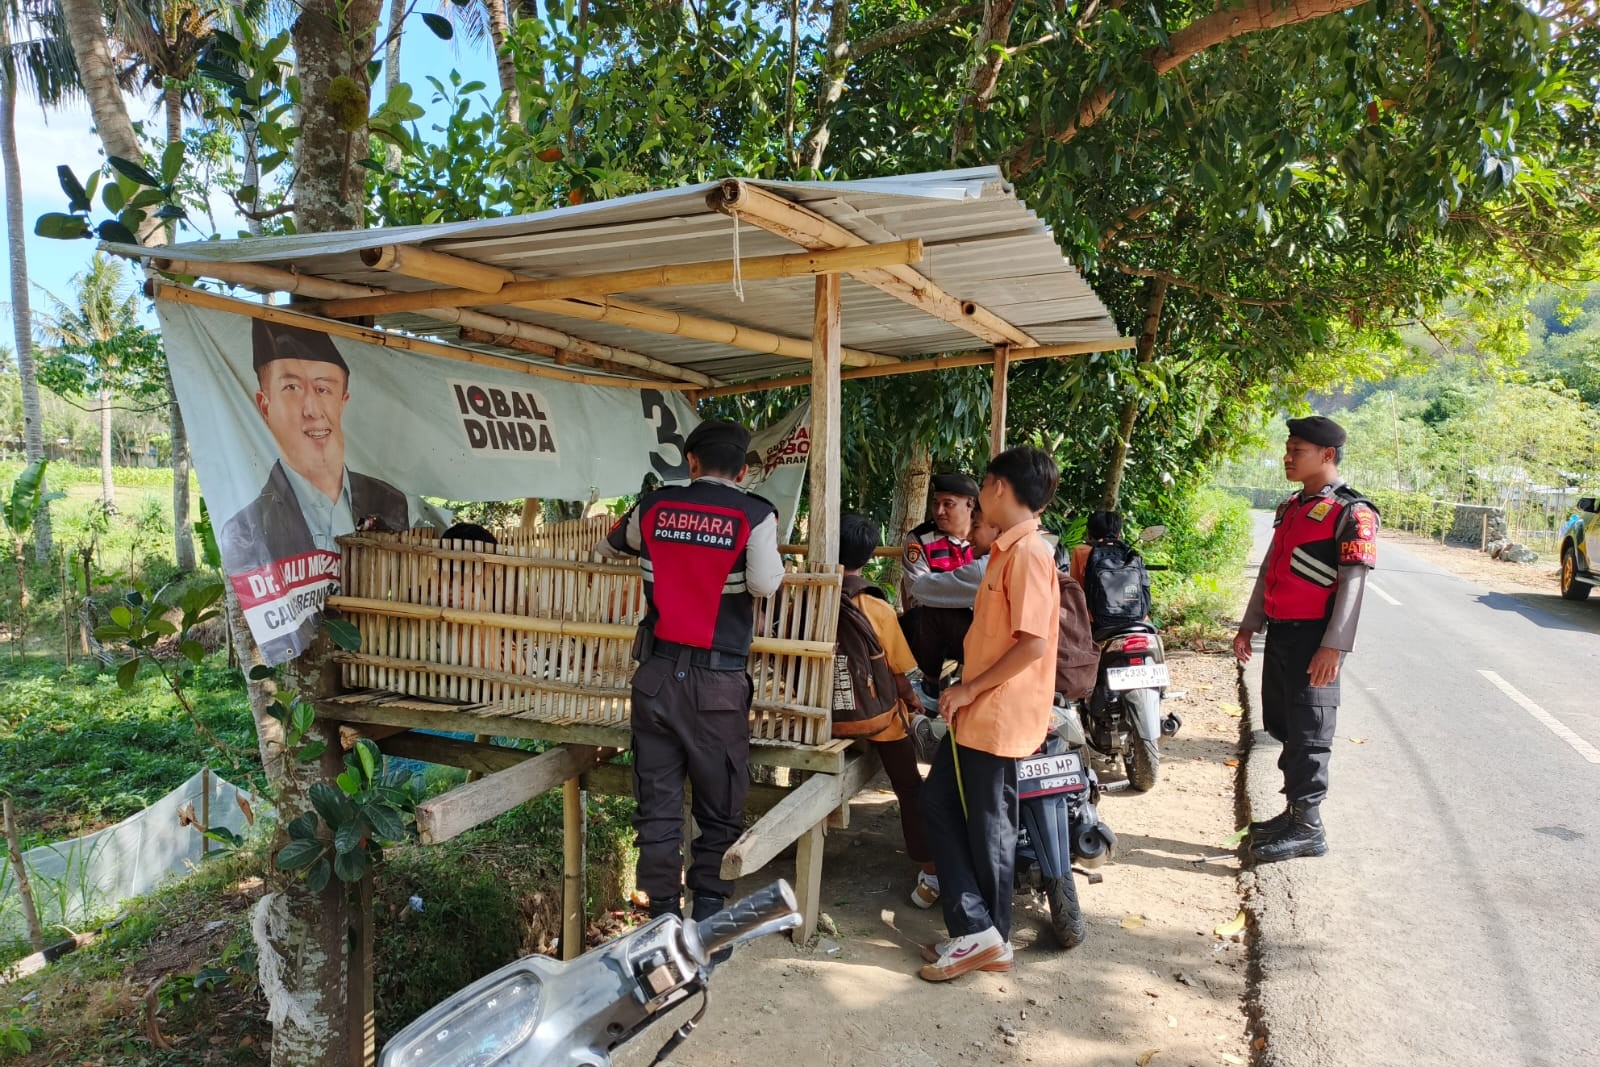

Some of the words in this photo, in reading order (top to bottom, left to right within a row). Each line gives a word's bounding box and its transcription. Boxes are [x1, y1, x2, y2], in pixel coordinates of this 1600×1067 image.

[453, 384, 547, 421] IQBAL
[463, 418, 556, 453] DINDA
[640, 388, 691, 481] 3
[657, 511, 734, 537] SABHARA
[655, 529, 692, 540] POLRES
[696, 534, 732, 546] LOBAR
[247, 574, 280, 599] Dr.
[1055, 759, 1073, 774] MP
